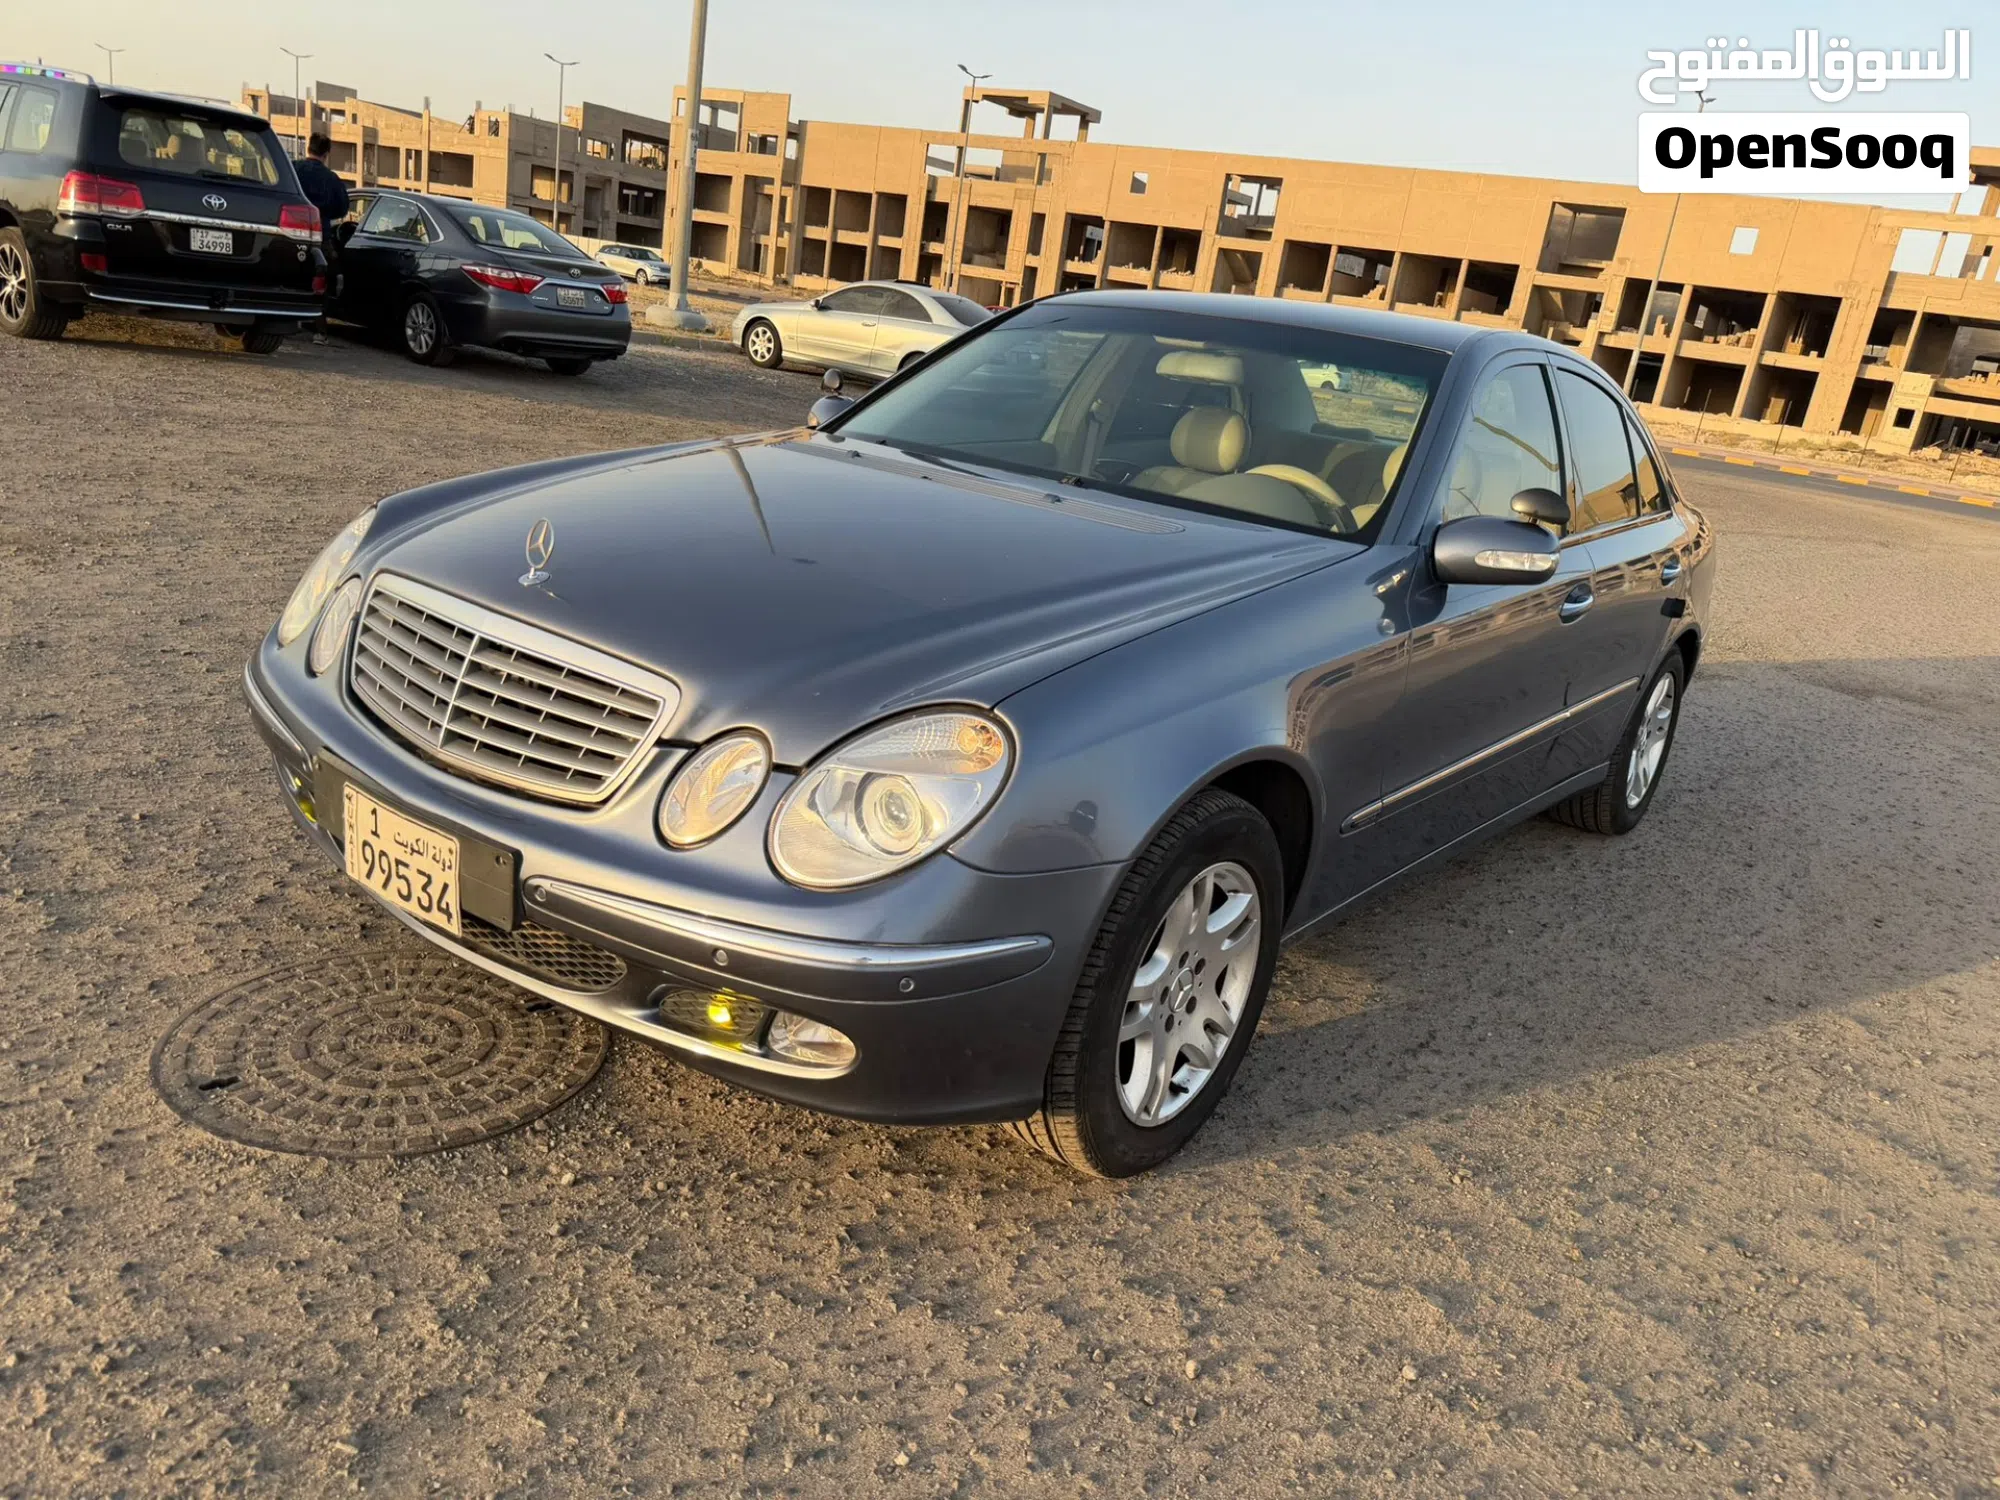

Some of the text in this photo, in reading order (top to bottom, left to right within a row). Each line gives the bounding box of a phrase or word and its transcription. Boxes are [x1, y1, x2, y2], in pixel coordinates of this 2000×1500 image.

[198, 239, 231, 253] 34998
[370, 807, 380, 839] 1
[394, 832, 453, 872] دولة الكويت
[361, 839, 453, 925] 99534
